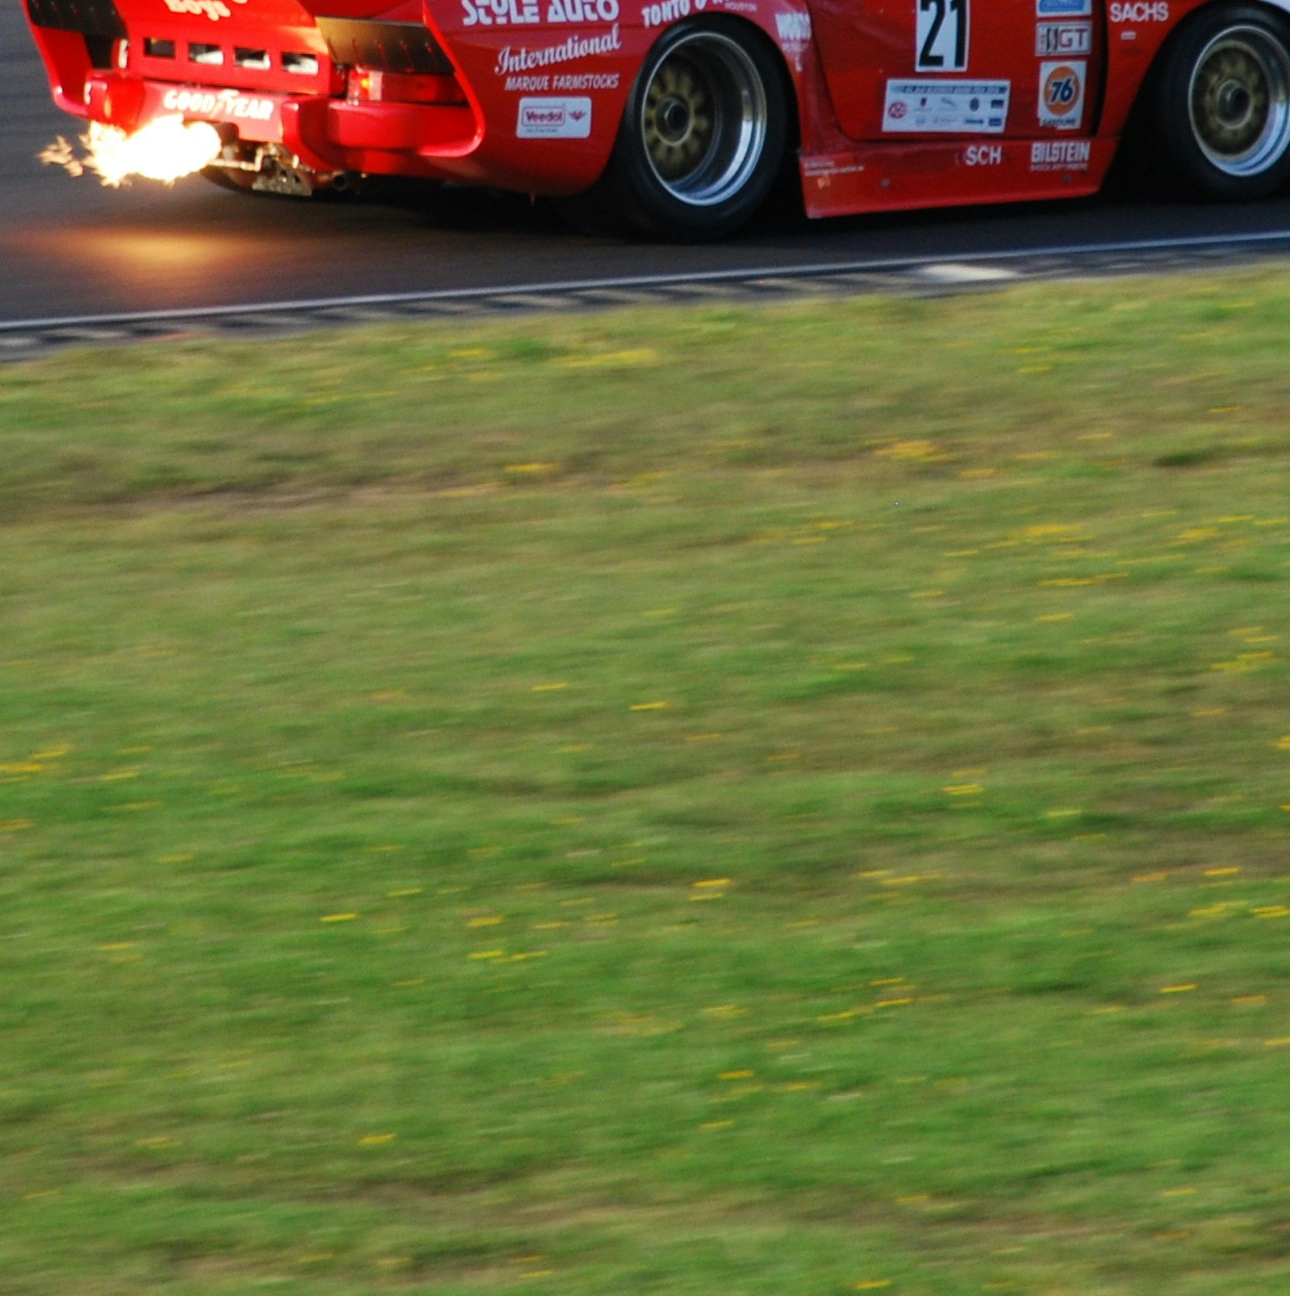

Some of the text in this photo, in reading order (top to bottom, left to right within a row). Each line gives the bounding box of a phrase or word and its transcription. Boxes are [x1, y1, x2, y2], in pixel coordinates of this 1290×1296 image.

[1110, 1, 1169, 23] SACHS
[494, 23, 622, 75] International
[505, 73, 620, 92] MARQUE FARMSTOCKS
[1050, 77, 1073, 103] 76
[1030, 142, 1091, 164] BILSTEIN
